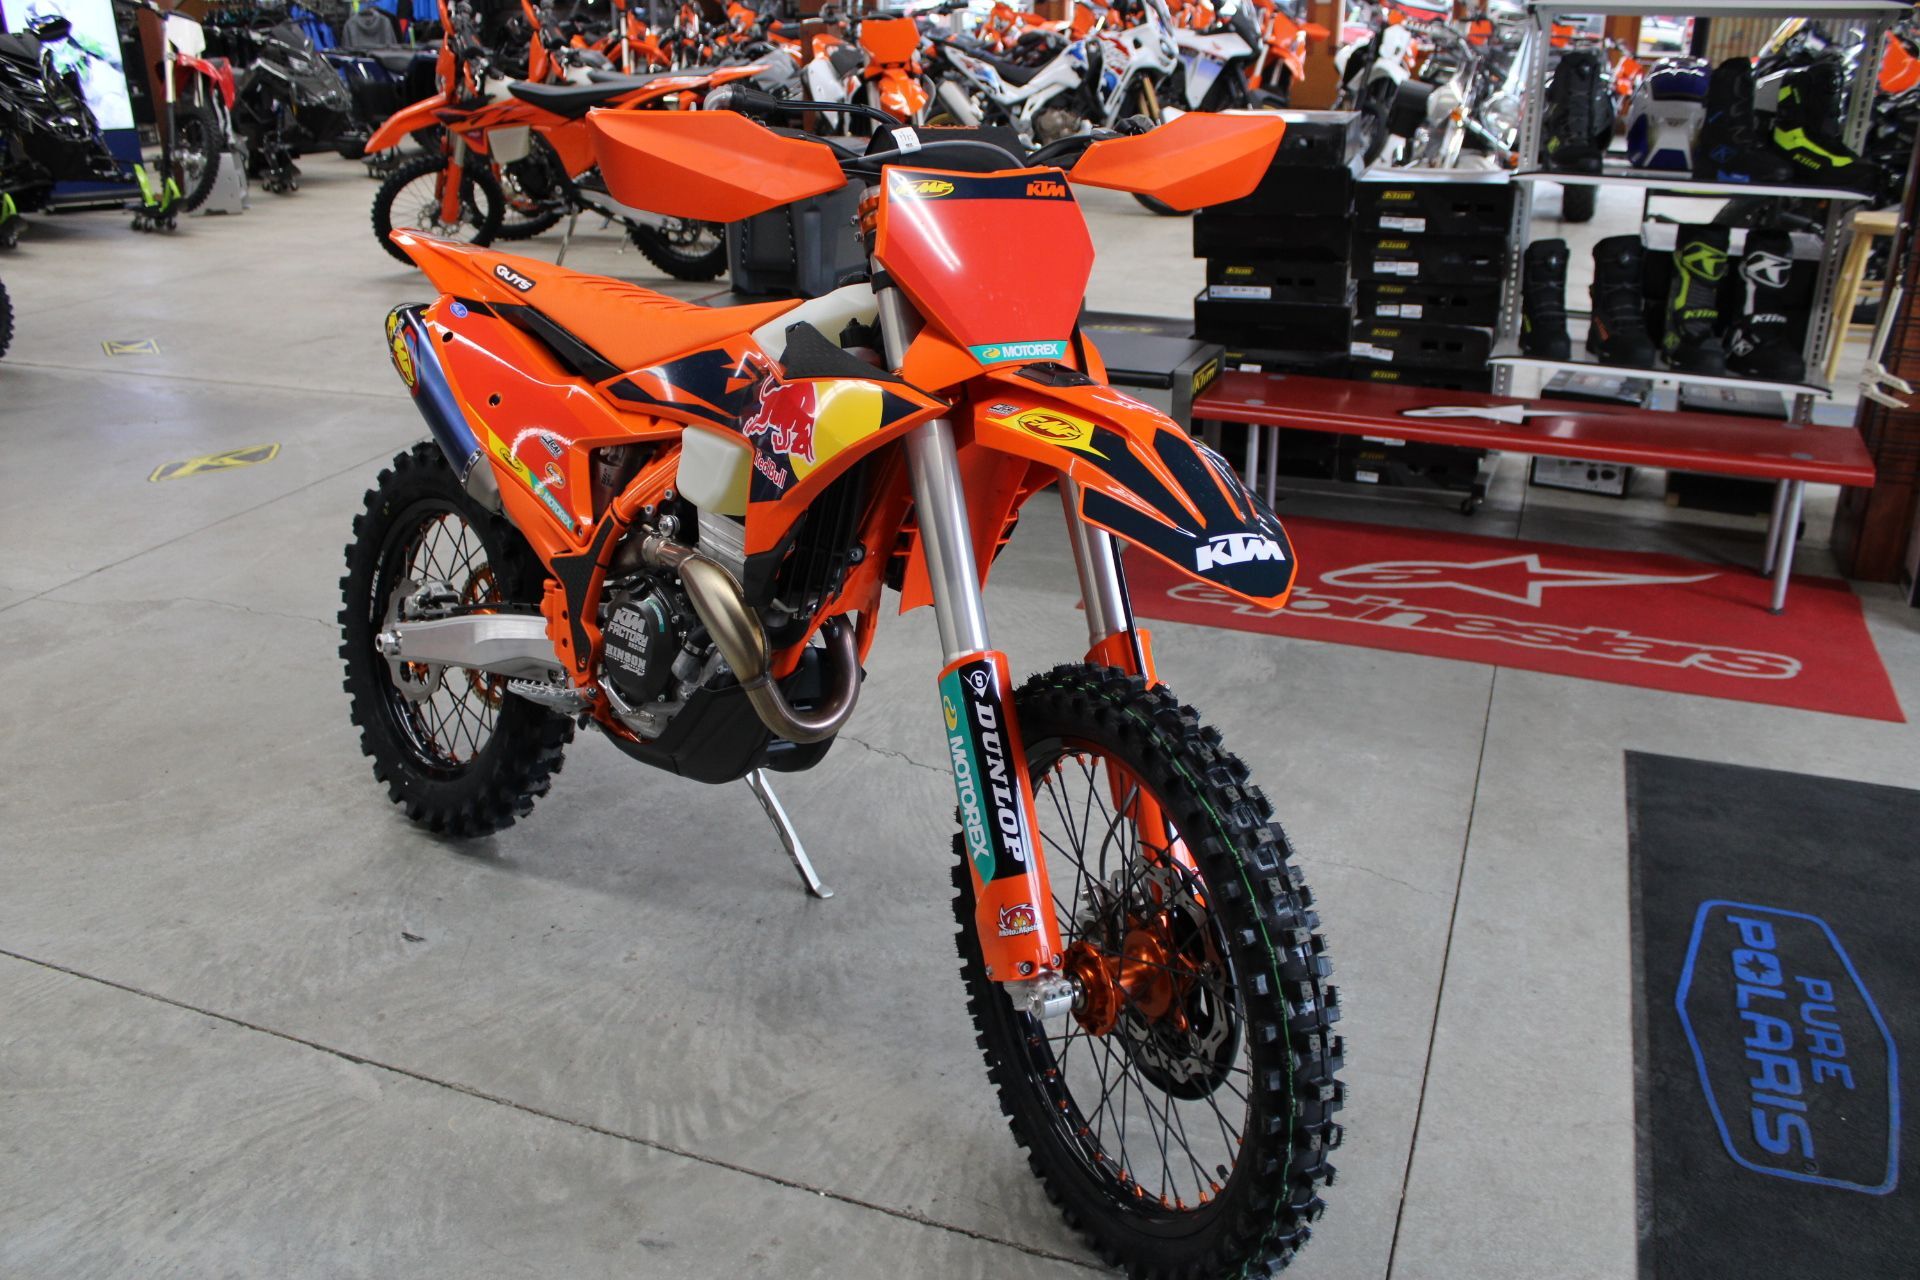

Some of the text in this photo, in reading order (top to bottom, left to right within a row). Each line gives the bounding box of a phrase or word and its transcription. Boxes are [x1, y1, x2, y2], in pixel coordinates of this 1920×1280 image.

[1026, 180, 1066, 197] KTM
[496, 264, 532, 290] GUTS
[1002, 343, 1058, 358] MOTOREX
[1196, 533, 1286, 572] KTM
[608, 620, 649, 648] FACTORY
[613, 607, 645, 634] KTM
[605, 643, 647, 671] HINSON
[974, 701, 1025, 863] DUNLOP
[950, 735, 990, 858] MOTOREX
[1726, 914, 1816, 1160] POLARIS
[1795, 975, 1856, 1090] PURE
